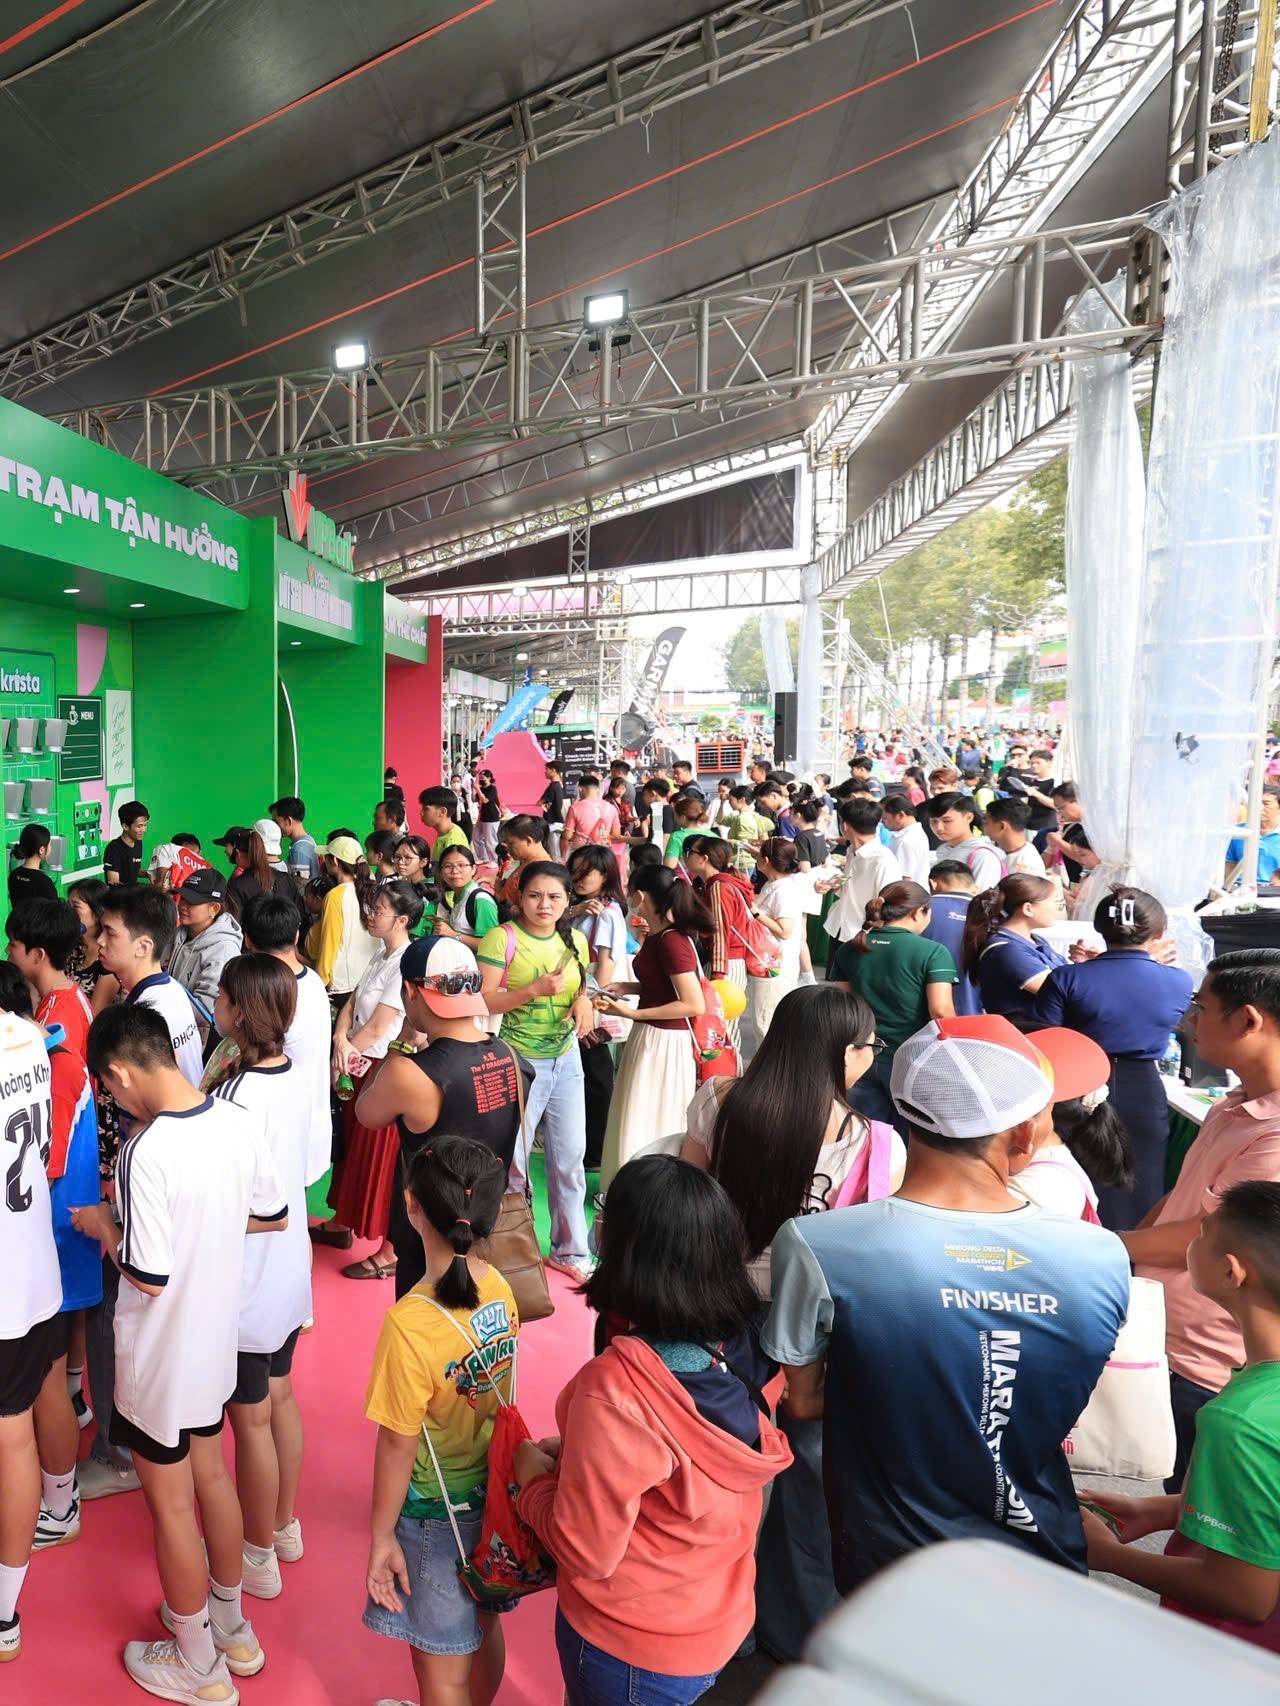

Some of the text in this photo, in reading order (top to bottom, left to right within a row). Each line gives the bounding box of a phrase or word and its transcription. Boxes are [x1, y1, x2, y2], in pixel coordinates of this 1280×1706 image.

[105, 496, 160, 547] TẬN
[165, 521, 239, 571] HƯỞNG
[81, 711, 94, 720] MENU
[957, 1257, 1005, 1265] MARATHON
[940, 1288, 1058, 1315] FINISHER
[979, 1330, 991, 1381] VIETCOMBANK
